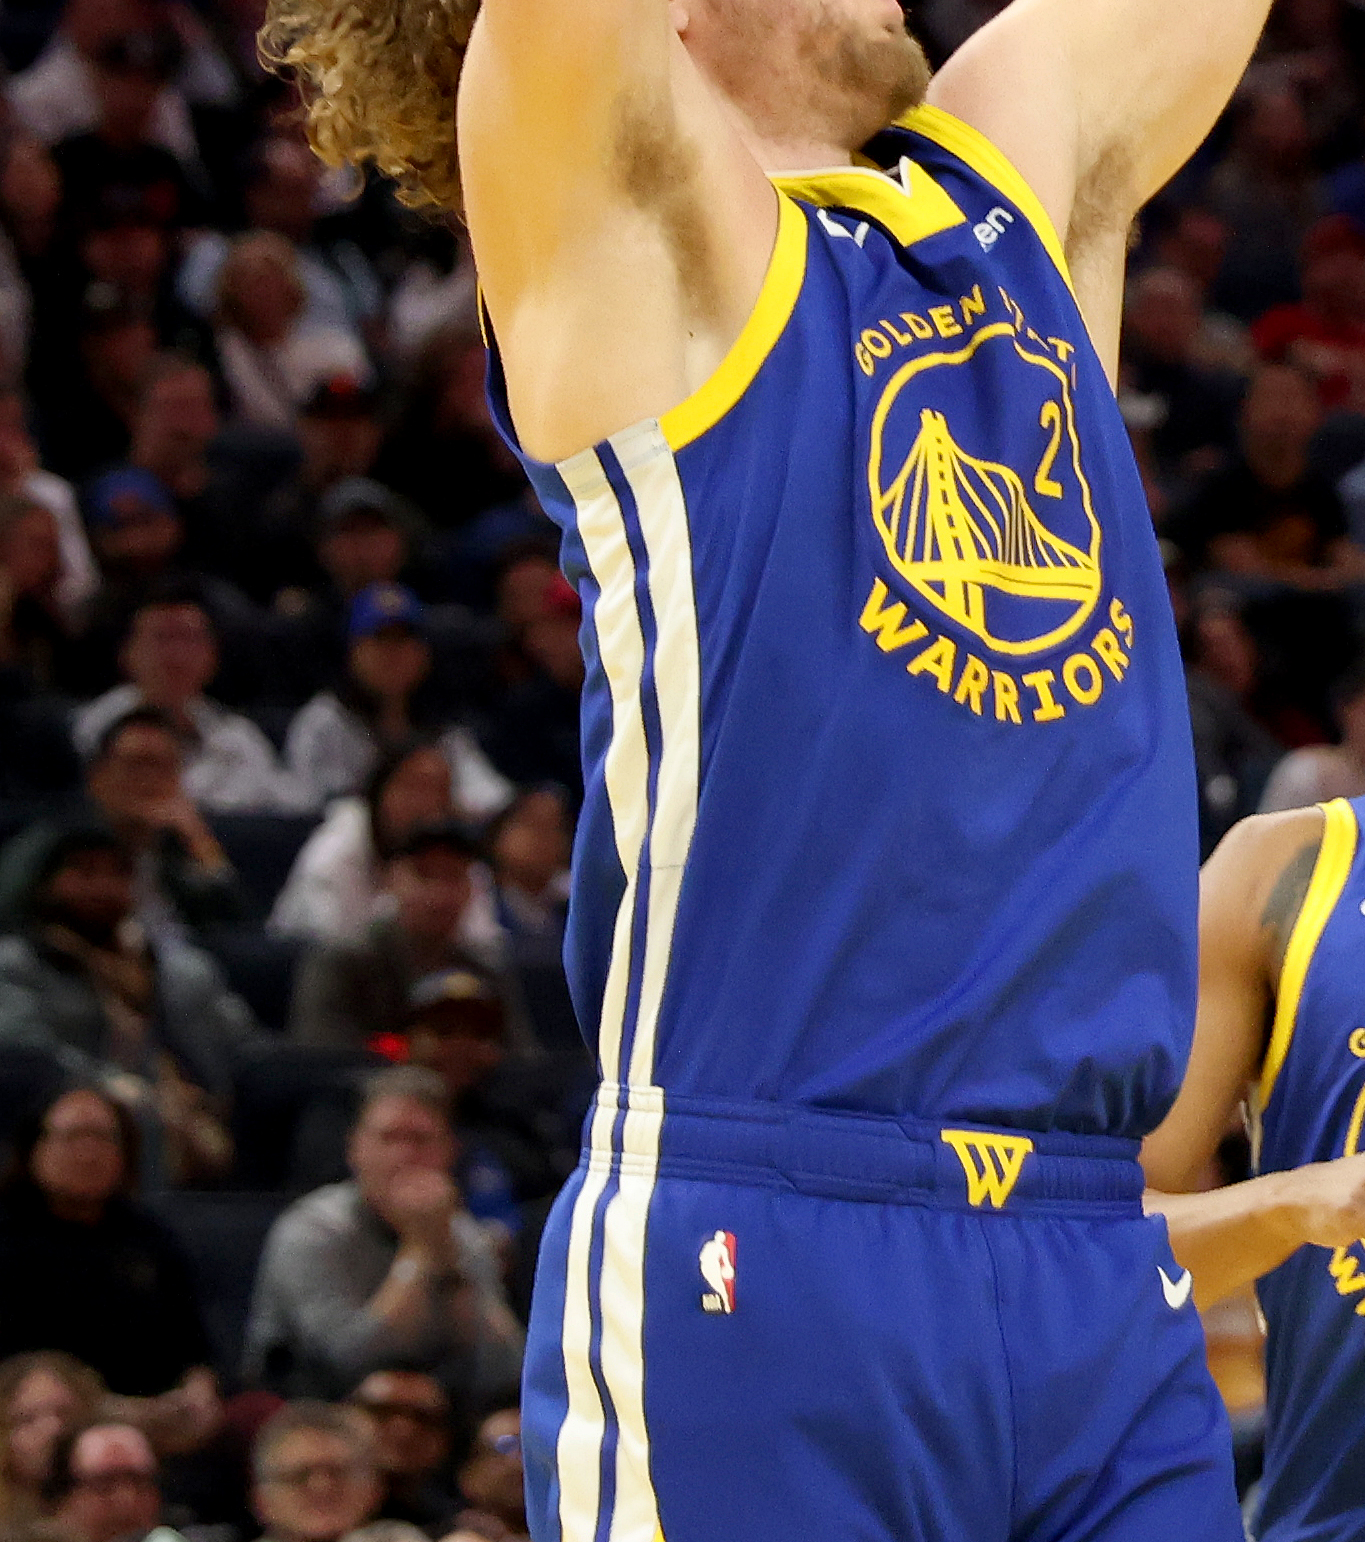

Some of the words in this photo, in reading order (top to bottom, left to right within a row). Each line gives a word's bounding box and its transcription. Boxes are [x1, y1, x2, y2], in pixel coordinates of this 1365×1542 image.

[854, 284, 988, 377] GOLDEN
[1033, 399, 1064, 500] 2
[857, 575, 1135, 725] WARRIORS
